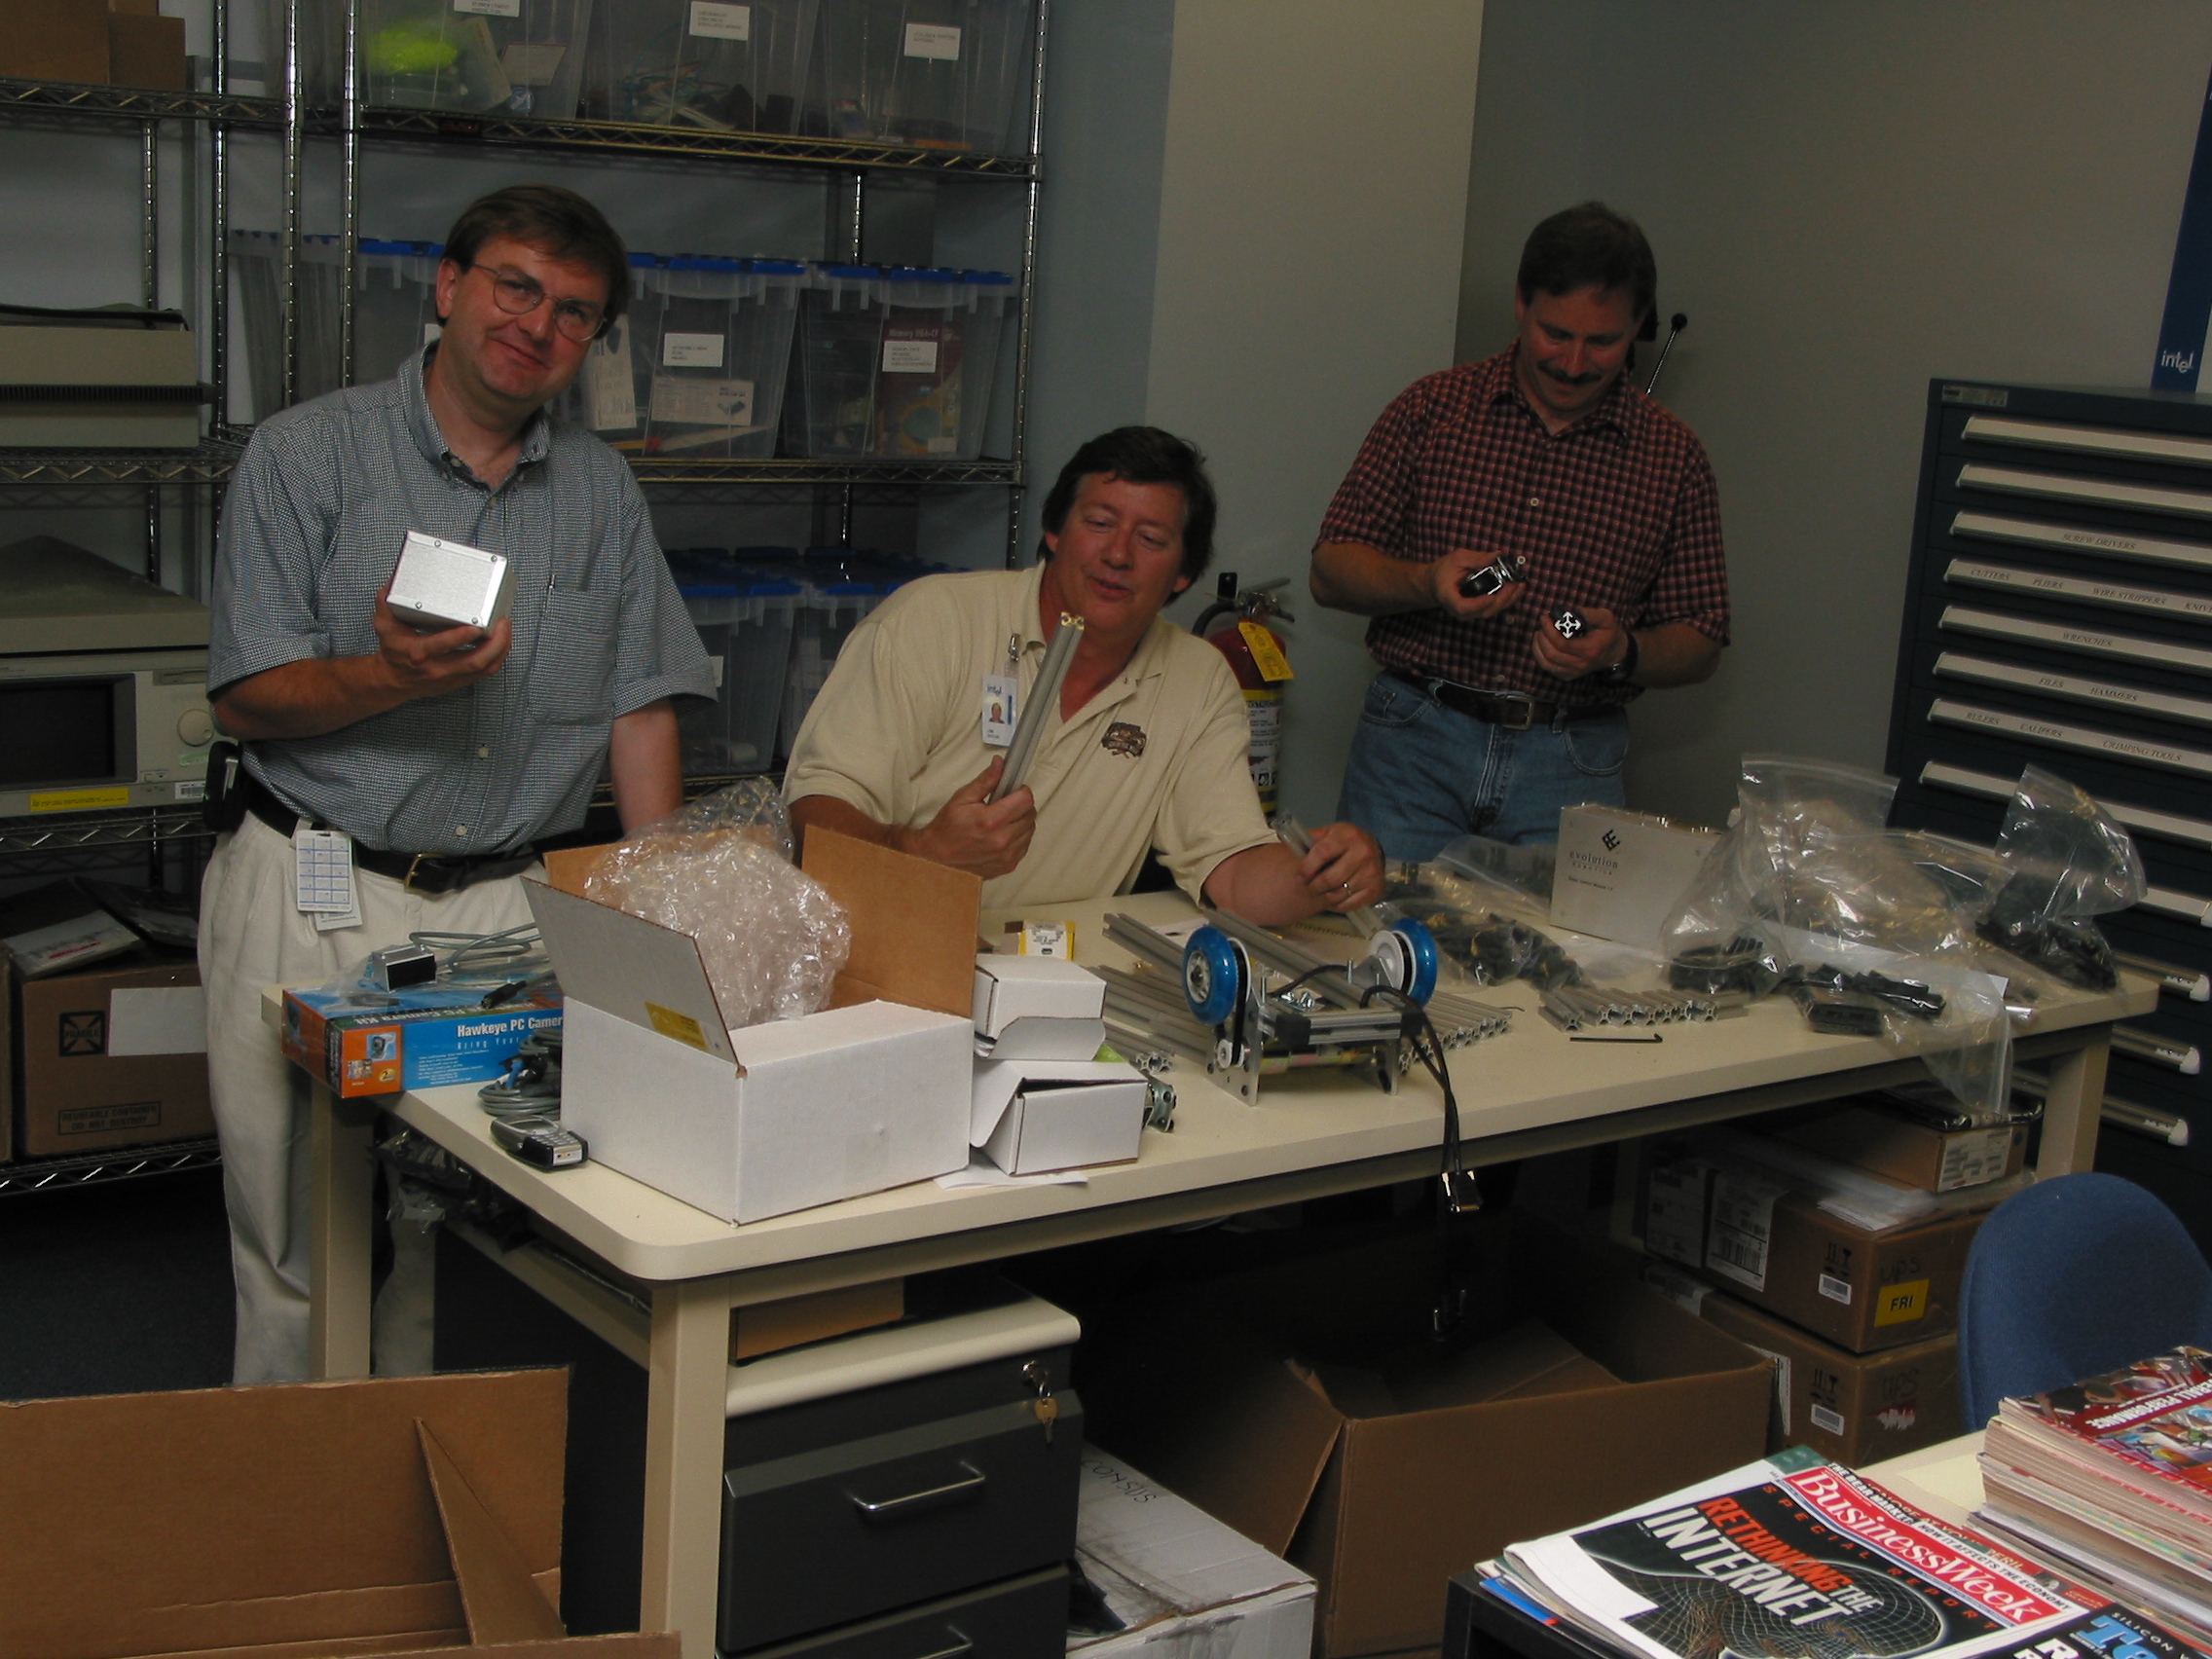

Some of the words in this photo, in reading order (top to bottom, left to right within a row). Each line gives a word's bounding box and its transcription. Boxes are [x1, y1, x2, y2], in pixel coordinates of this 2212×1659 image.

[2160, 350, 2194, 373] intel
[2062, 533, 2092, 543] SCREW
[2095, 538, 2136, 549] DRIVERS
[2032, 578, 2063, 589] PLIERS
[2092, 587, 2115, 597] WIRE
[2118, 592, 2166, 605] STRIPPERS
[2063, 632, 2112, 646] WRENCHES
[2039, 678, 2063, 687] FILES
[2089, 687, 2138, 702] HAMMERS
[1966, 712, 2000, 724] RULERS
[2019, 723, 2063, 737] CALIPERS
[2102, 740, 2149, 755] CRIMPING
[2151, 750, 2182, 761] TOOLS
[1569, 852, 1618, 868] evolution
[64, 1028, 98, 1039] FRAGILE
[457, 1022, 507, 1038] Hawkeye
[510, 1018, 525, 1031] PC
[457, 1040, 488, 1050] Bring
[111, 1104, 158, 1116] CONTAINER
[89, 1120, 105, 1128] NOT
[109, 1116, 147, 1127] DESTROY
[1890, 1296, 1914, 1311] FRI
[1828, 1462, 1850, 1477] THE
[1847, 1473, 1874, 1497] BEAR
[1918, 1524, 1942, 1539] HOW
[1953, 1542, 2001, 1569] AFFECTS
[2000, 1567, 2023, 1581] THE
[2018, 1577, 2072, 1611] ECONOMY
[1697, 1496, 1855, 1592] RETHINKING
[1828, 1583, 1885, 1614] THE
[1790, 1471, 2044, 1623] BusinessWeek
[1761, 1485, 1872, 1560] SPECIAL
[1887, 1567, 1999, 1630] REPORT
[1641, 1506, 1854, 1627] INTERNET
[2111, 1611, 2174, 1652] SILICON
